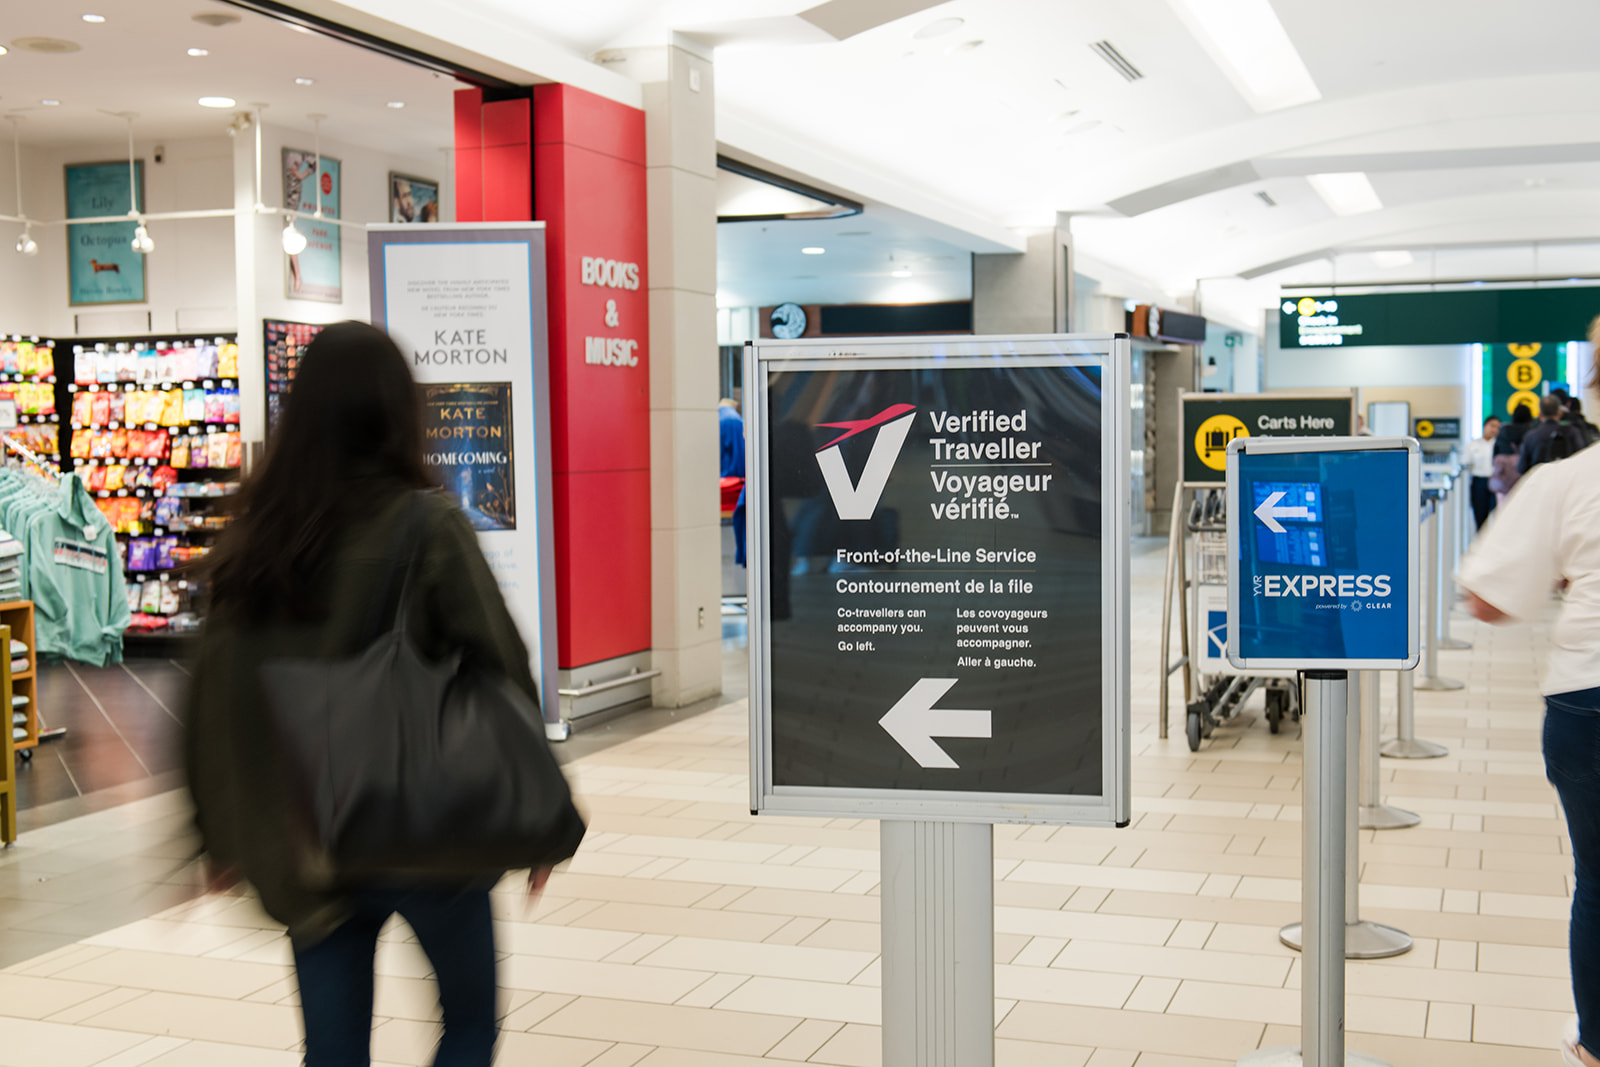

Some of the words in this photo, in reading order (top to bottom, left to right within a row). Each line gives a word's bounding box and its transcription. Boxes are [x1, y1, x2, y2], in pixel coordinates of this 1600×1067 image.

[81, 234, 127, 248] Octopus
[581, 256, 639, 291] BOOKS
[605, 299, 619, 327] &
[435, 329, 486, 345] KATE
[414, 349, 507, 365] MORTON
[585, 336, 638, 368] MUSIC
[1518, 365, 1533, 382] B
[440, 408, 486, 420] KATE
[930, 410, 1026, 432] Verified
[1258, 415, 1296, 429] Carts
[1301, 416, 1334, 429] Here
[426, 426, 502, 439] MORTON
[930, 438, 1041, 460] Traveller
[423, 452, 507, 465] HOMECOMING
[931, 471, 1051, 497] Voyageur
[837, 549, 971, 563] Front-of-the-Line
[976, 549, 1036, 562] Service
[837, 579, 960, 593] Contournement
[965, 579, 984, 593] de
[990, 579, 1003, 593] la
[1008, 579, 1033, 593] file
[1253, 575, 1262, 596] YVR
[1265, 575, 1391, 597] EXPRESS
[838, 608, 904, 617] Co-travellers
[957, 608, 975, 618] Les
[979, 610, 1047, 620] covoyageurs
[838, 624, 897, 634] accompany
[901, 625, 923, 634] you.
[957, 624, 999, 634] peuvent
[1002, 625, 1028, 633] vous
[838, 641, 853, 651] Go
[857, 641, 875, 650] left.
[957, 640, 1031, 649] accompagner.
[957, 657, 981, 666] Aller
[985, 657, 990, 666] à
[994, 658, 1036, 669] gauche.
